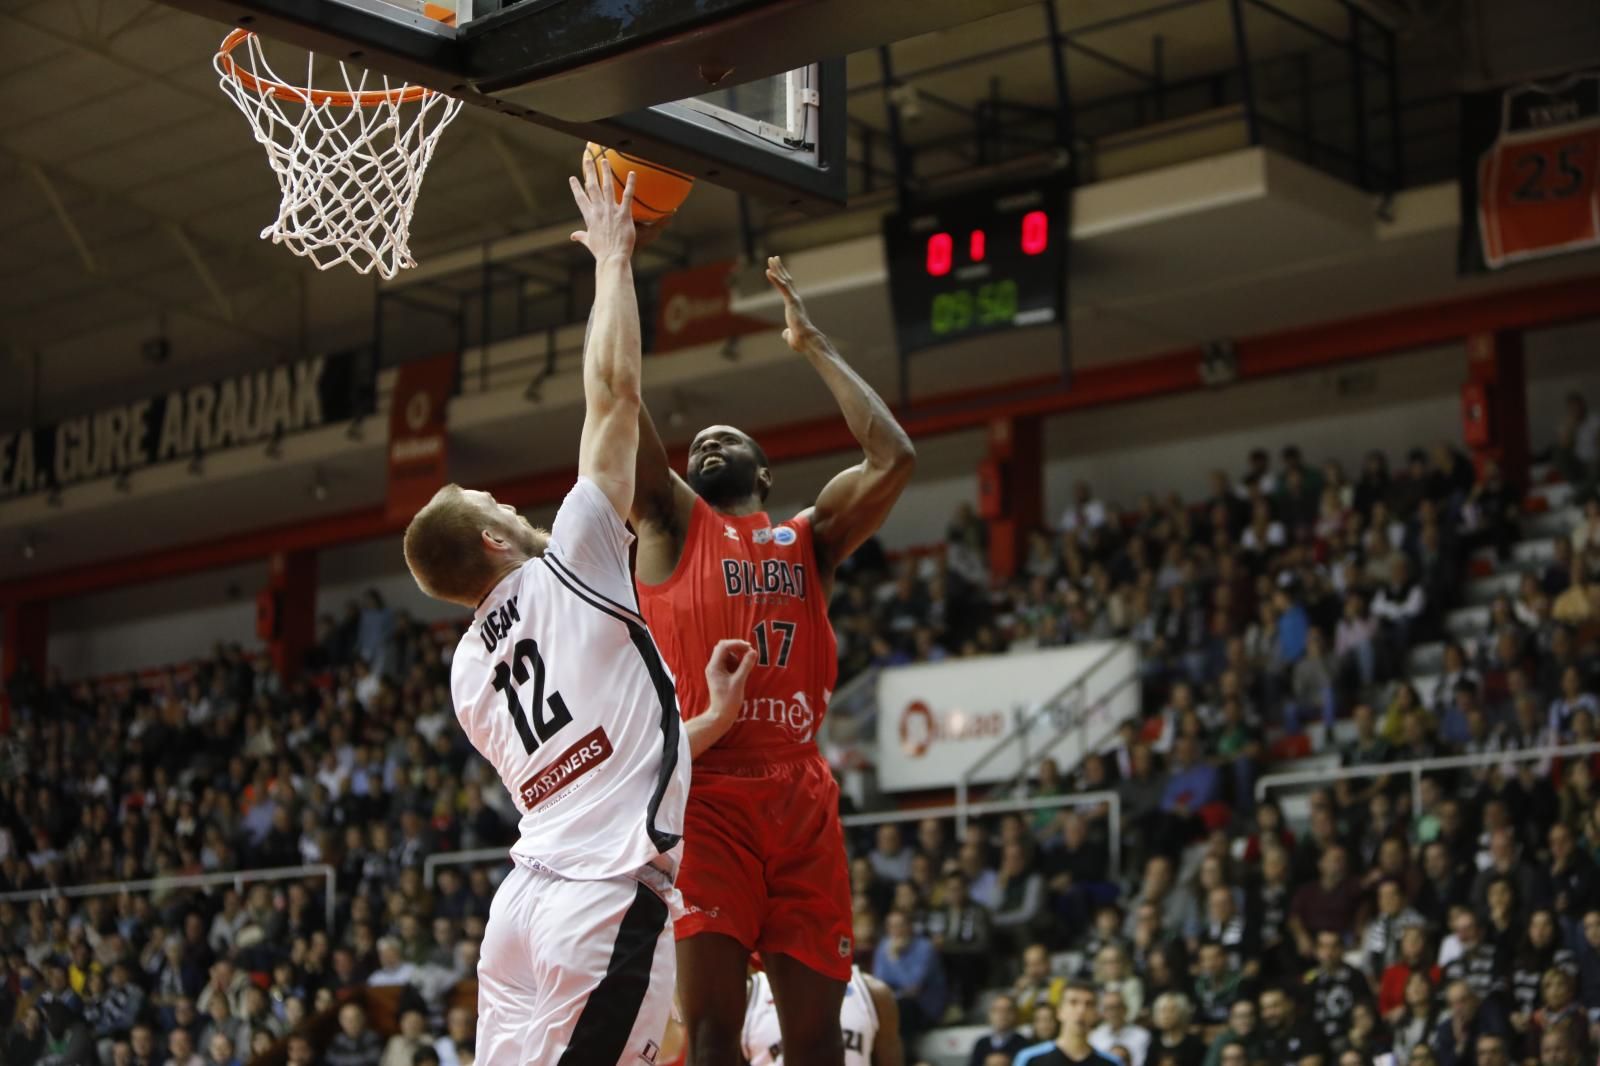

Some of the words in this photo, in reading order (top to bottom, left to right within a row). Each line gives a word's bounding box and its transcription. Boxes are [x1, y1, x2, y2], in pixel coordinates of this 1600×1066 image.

[1513, 144, 1584, 200] 25
[1021, 210, 1048, 256] 0
[56, 400, 151, 479] GURE
[158, 355, 326, 458] ARAUAK
[752, 620, 797, 668] 17
[492, 638, 574, 756] 12
[525, 738, 603, 803] PARTNERS
